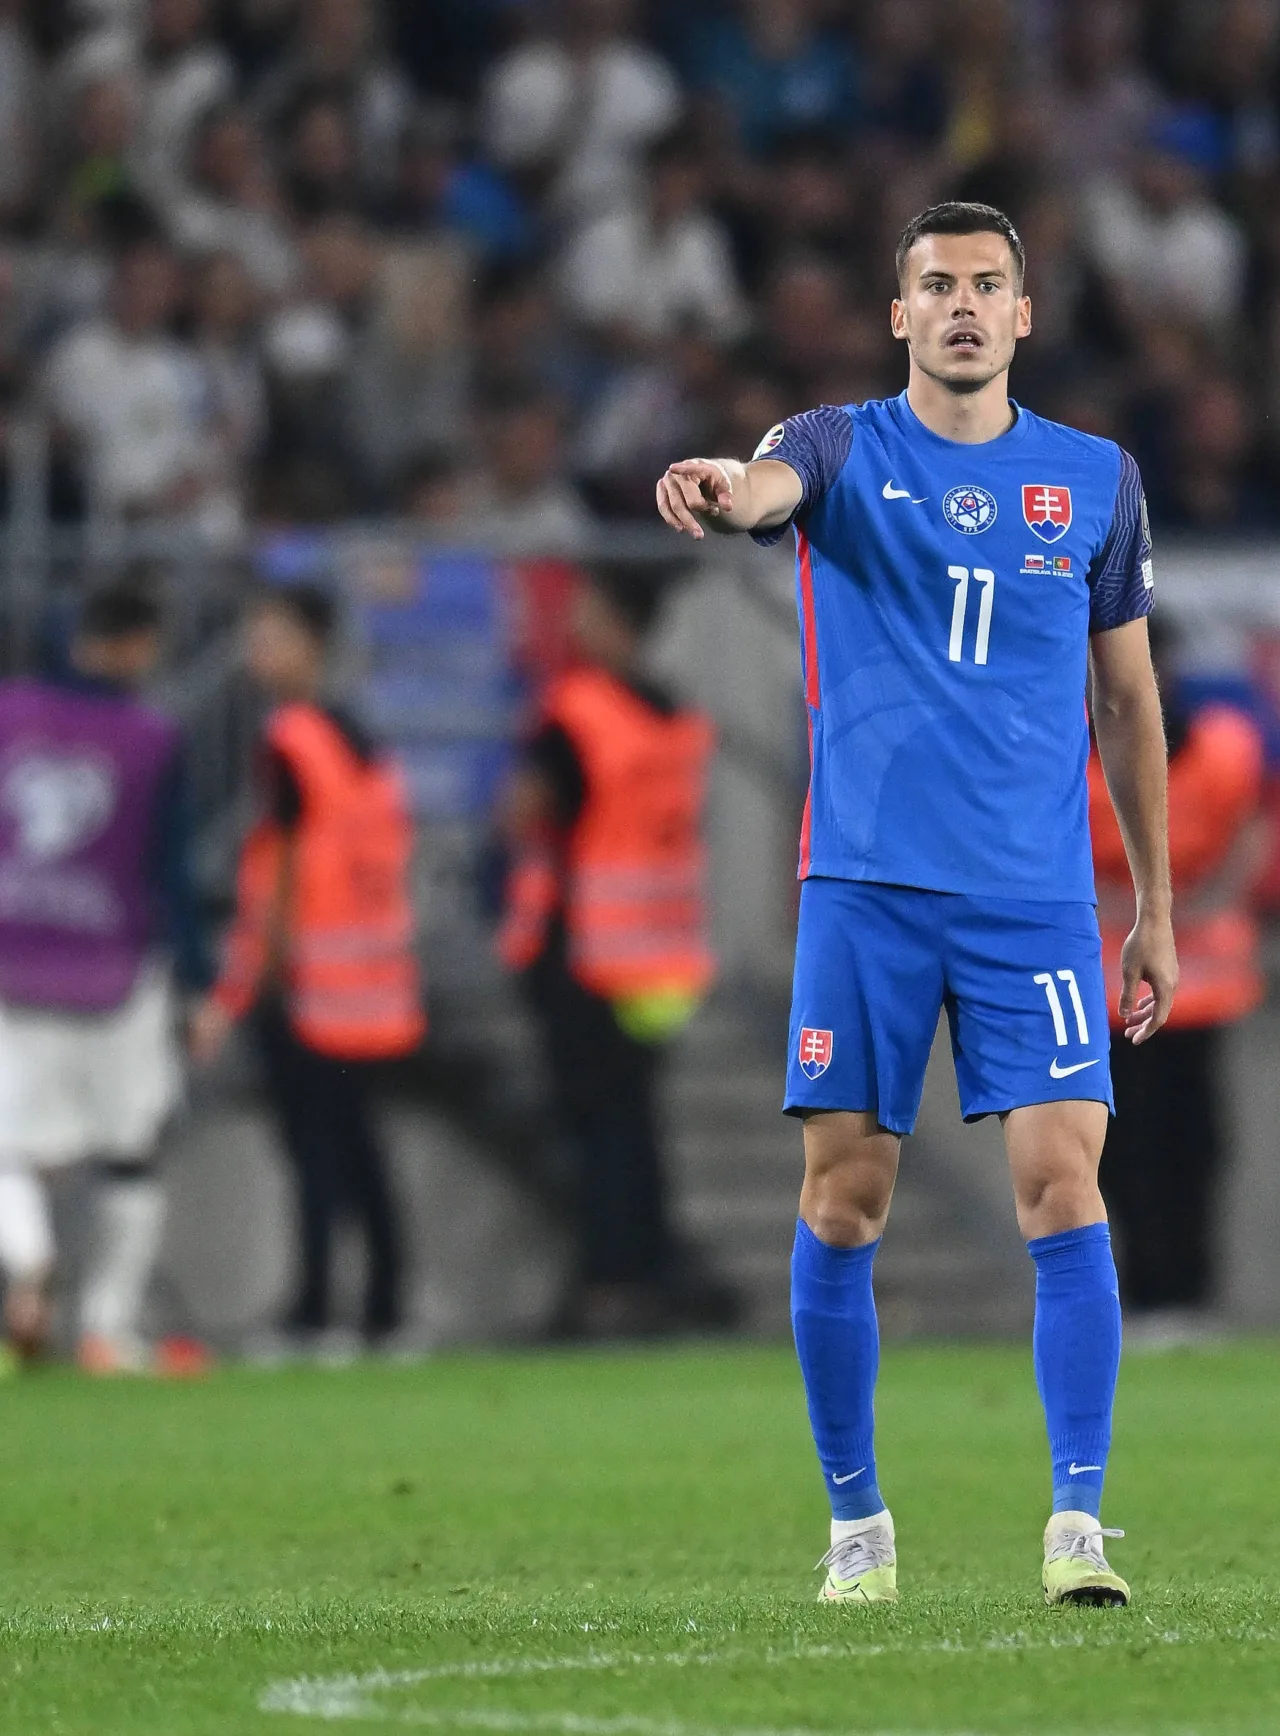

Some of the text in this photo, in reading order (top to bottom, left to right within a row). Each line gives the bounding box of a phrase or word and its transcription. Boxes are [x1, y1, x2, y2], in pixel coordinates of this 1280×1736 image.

[1019, 568, 1052, 576] BRATISLAVA
[947, 565, 995, 665] 11
[1033, 969, 1089, 1046] 11
